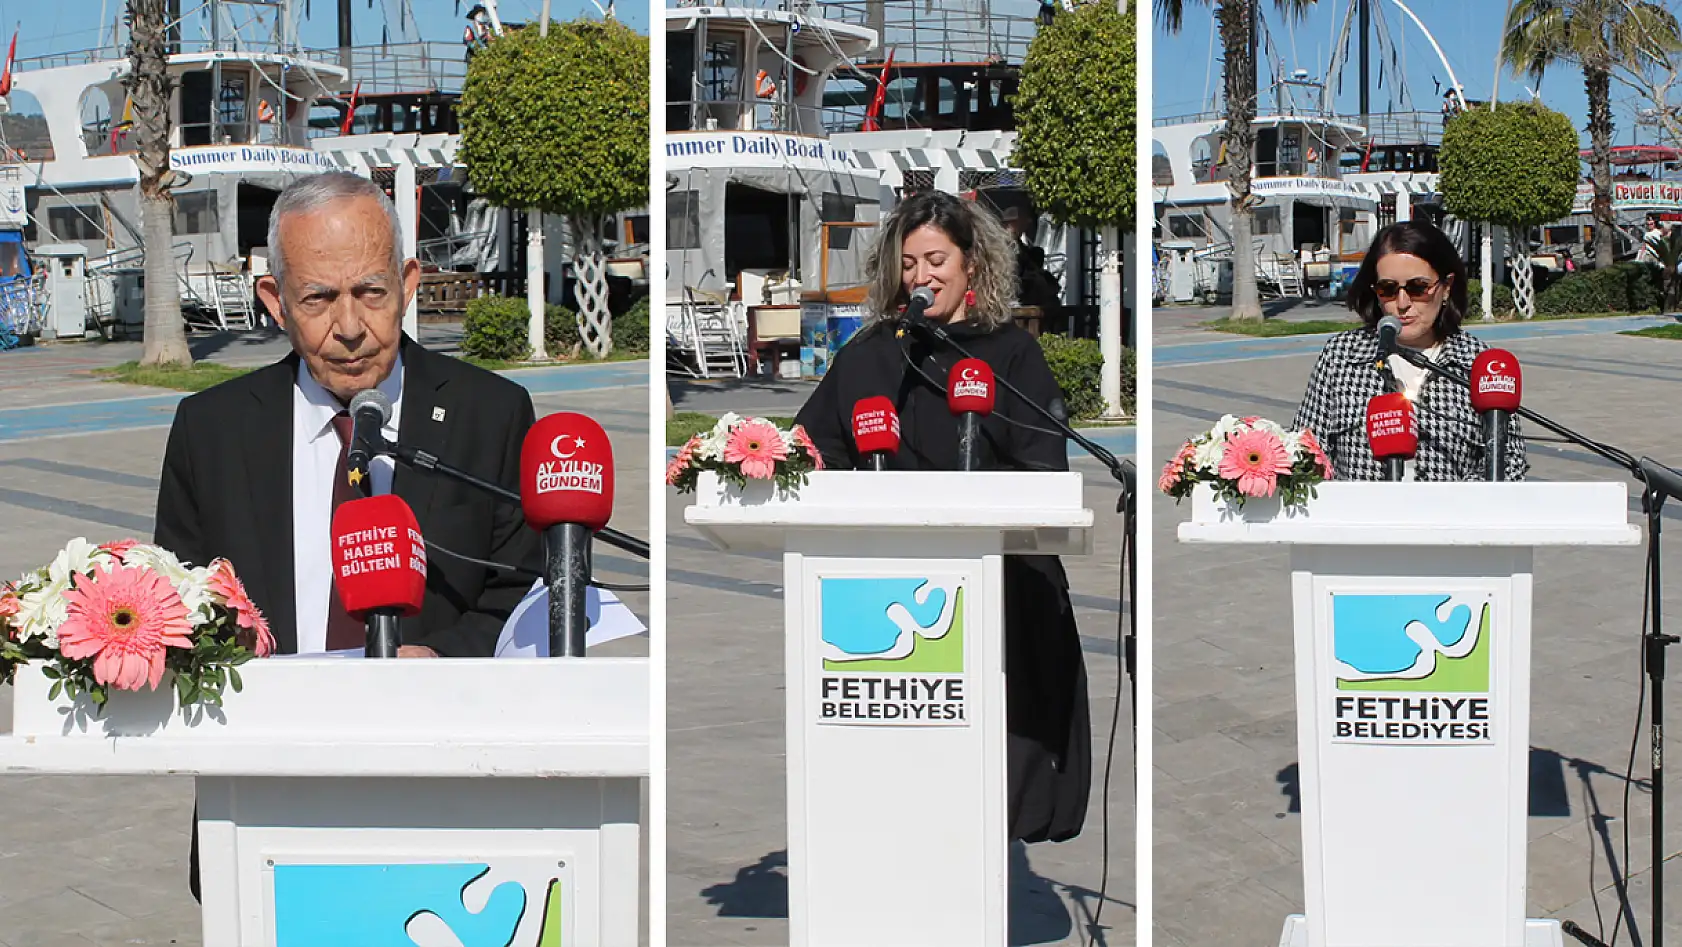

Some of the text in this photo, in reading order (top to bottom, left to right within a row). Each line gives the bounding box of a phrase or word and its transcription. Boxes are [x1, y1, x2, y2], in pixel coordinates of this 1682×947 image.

[732, 136, 777, 159] Daily
[785, 138, 823, 158] Boat
[171, 150, 236, 167] Summer
[242, 148, 276, 164] Daily
[281, 149, 309, 164] Boat
[1296, 178, 1319, 190] Daily
[1615, 184, 1654, 200] Cevdet
[539, 460, 603, 475] AY YILDIZ
[540, 475, 600, 490] GÜNDEM
[338, 526, 398, 547] FETHİYE
[343, 541, 394, 560] HABER
[341, 554, 401, 577] BÜLTENİ
